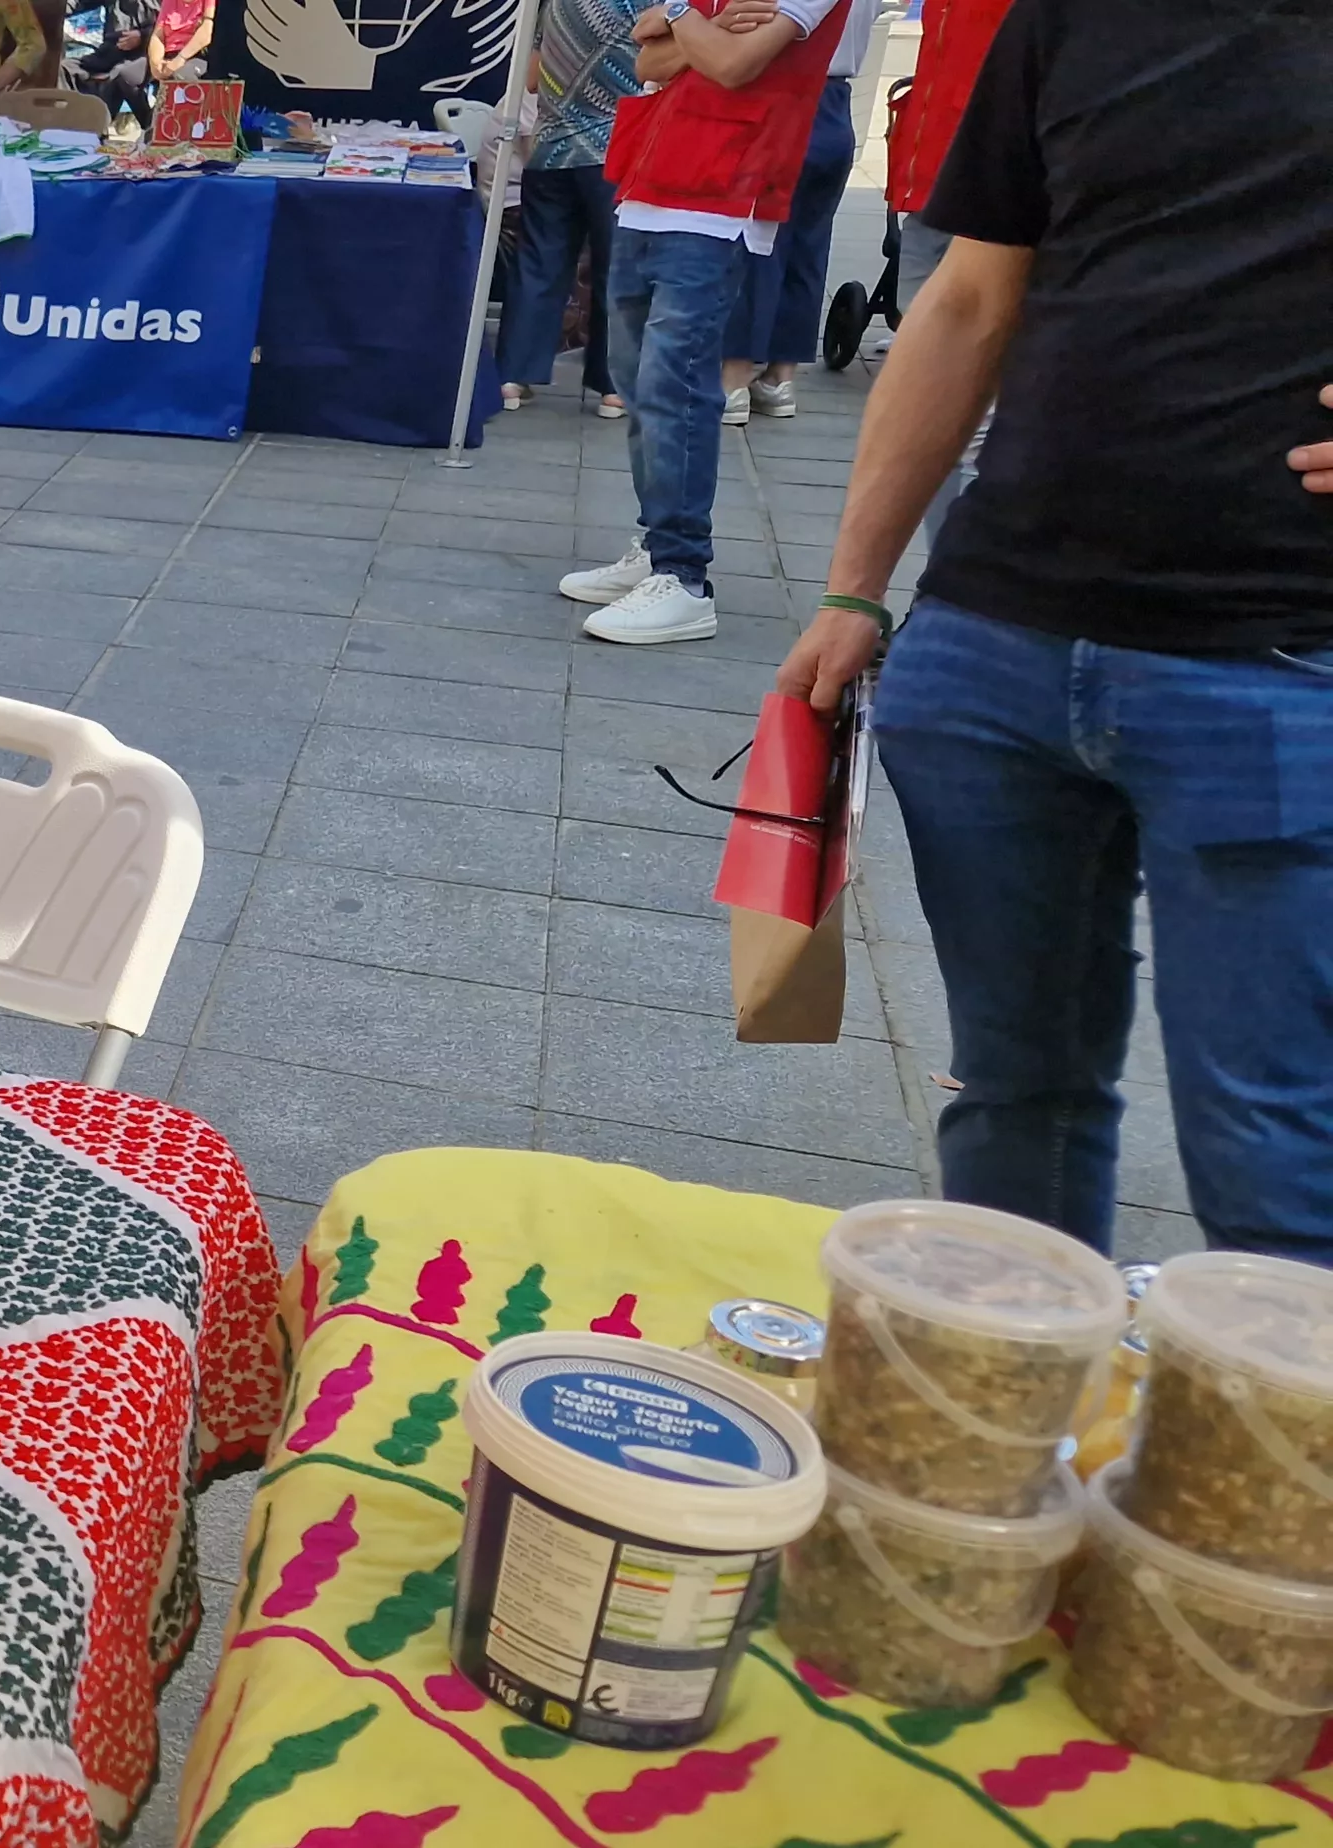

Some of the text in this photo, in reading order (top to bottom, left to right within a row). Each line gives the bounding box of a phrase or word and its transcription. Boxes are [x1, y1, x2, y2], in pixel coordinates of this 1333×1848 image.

[2, 293, 202, 343] Unidas
[552, 1385, 617, 1409] Yogur
[615, 1424, 691, 1449] griego
